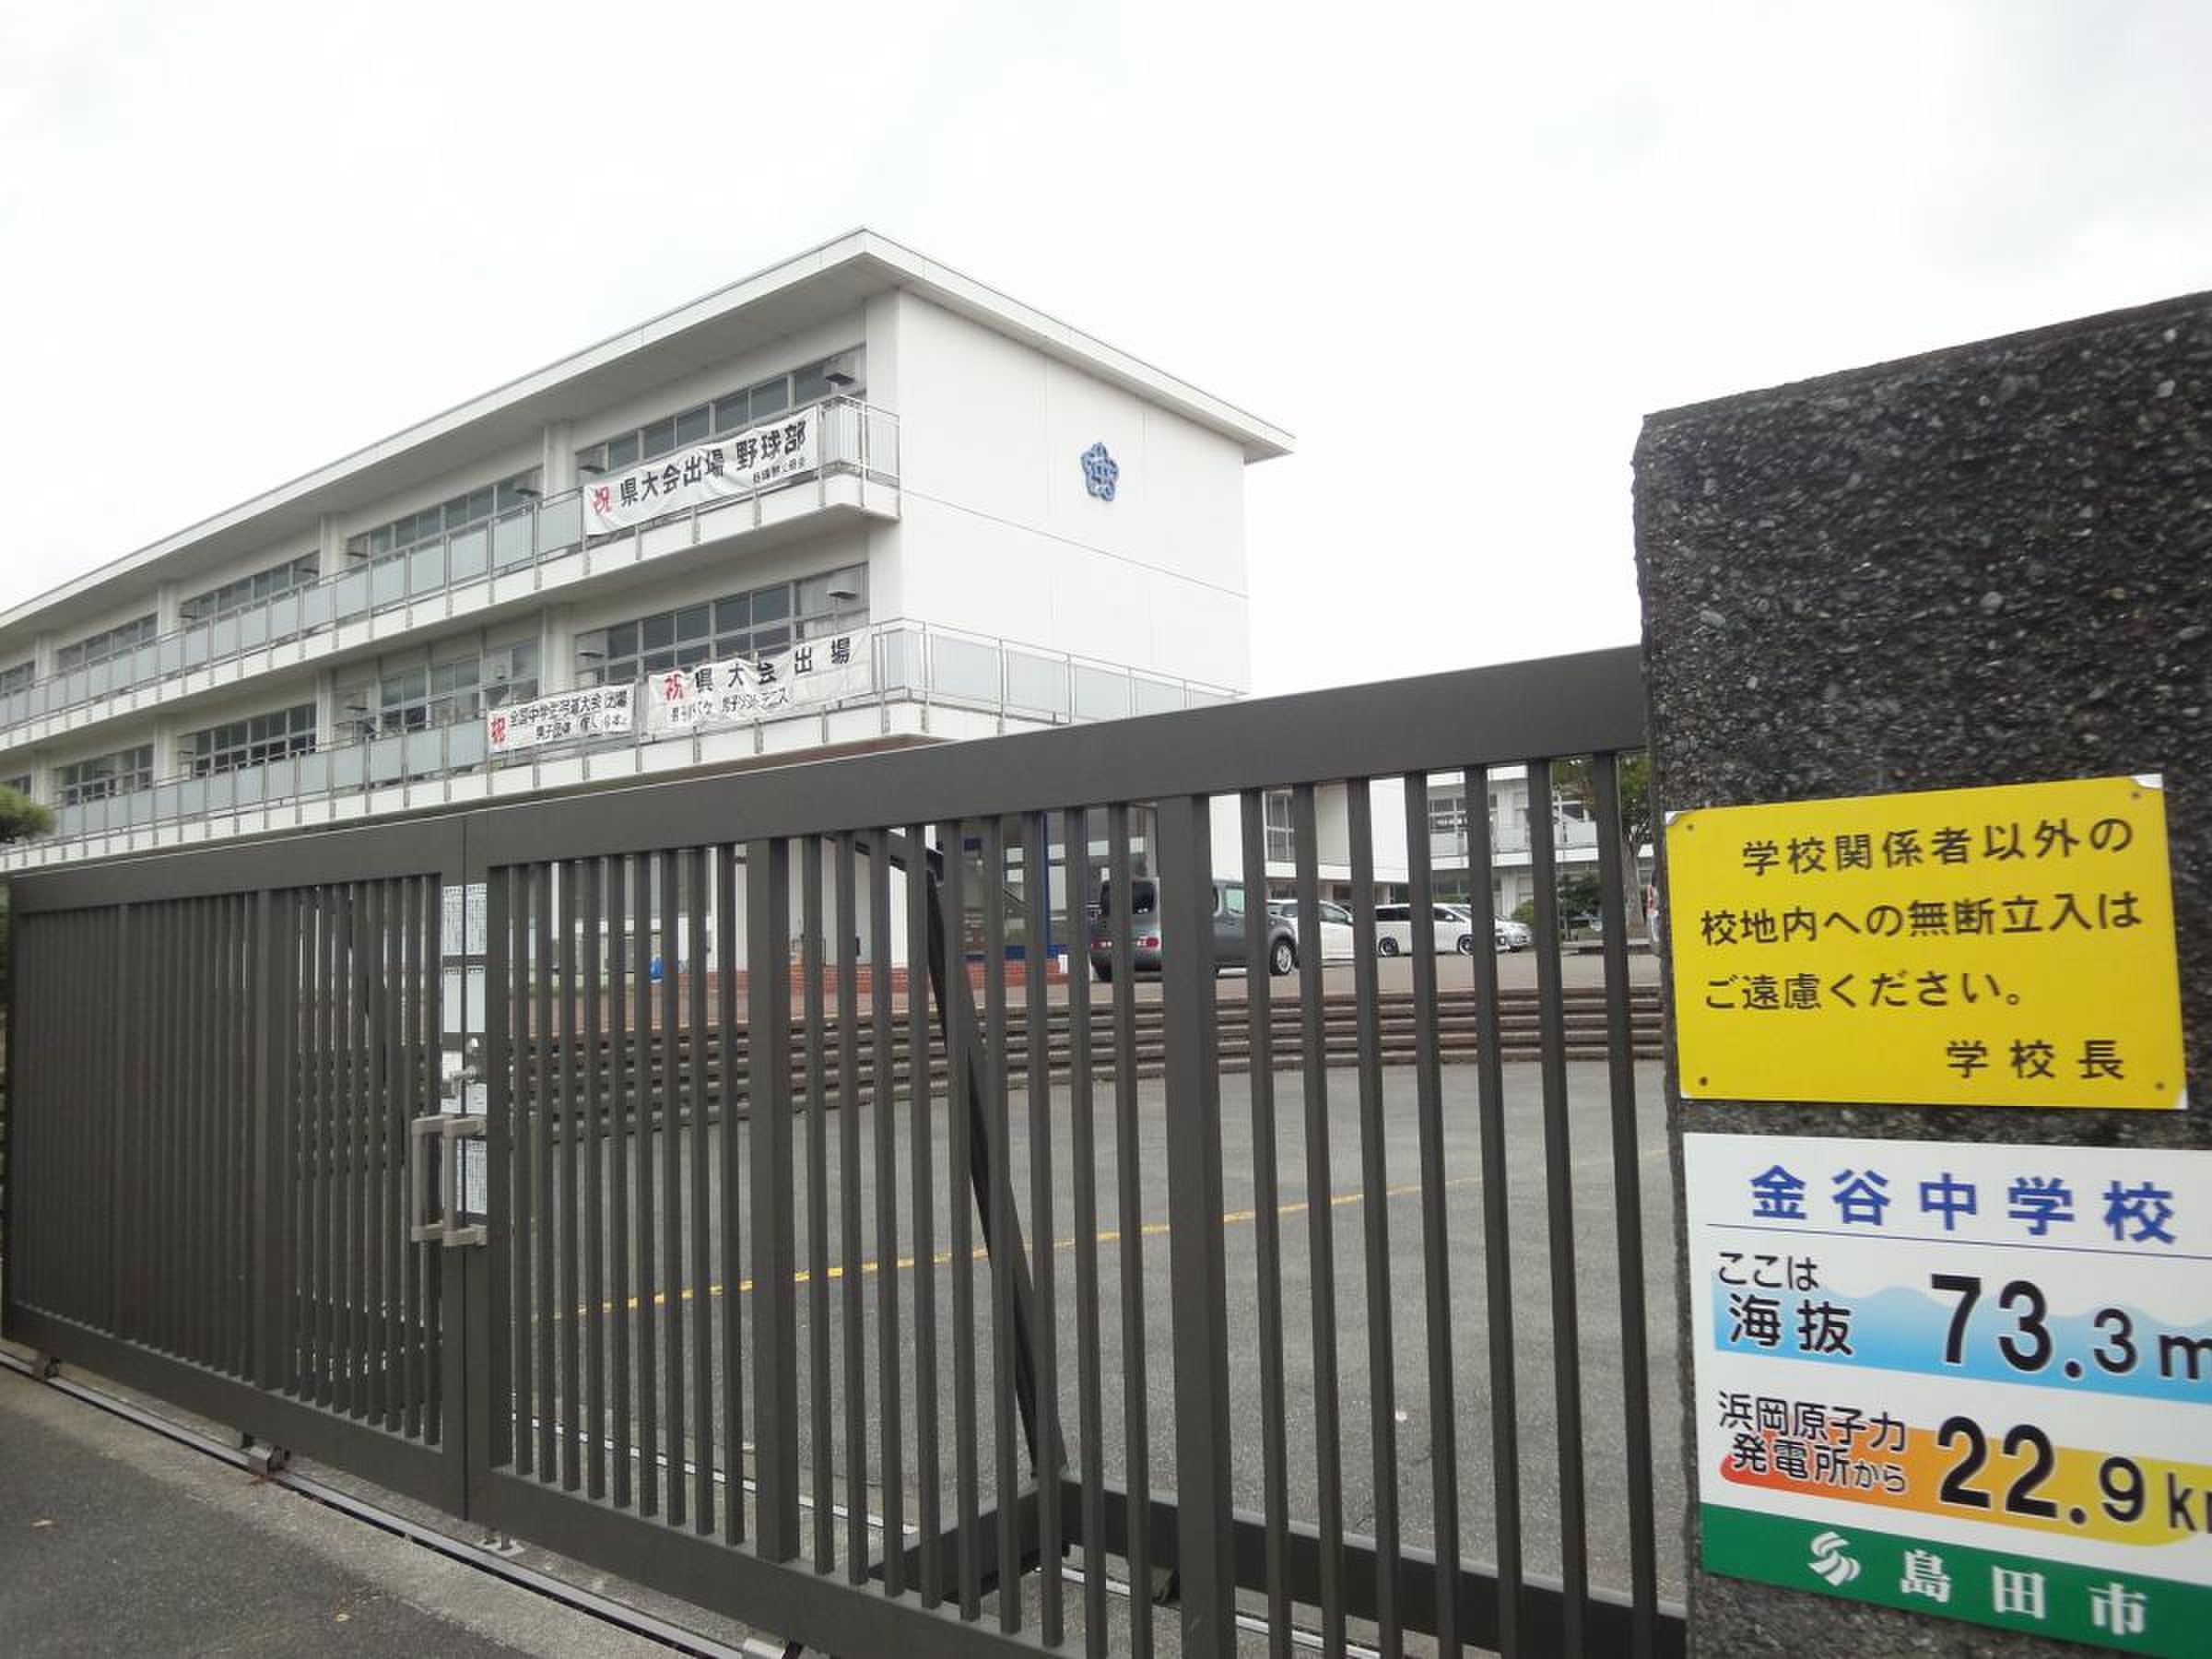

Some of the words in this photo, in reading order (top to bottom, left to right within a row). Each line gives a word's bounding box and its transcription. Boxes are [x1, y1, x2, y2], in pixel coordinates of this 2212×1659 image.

[619, 447, 725, 508] 県大会出場
[735, 420, 807, 472] 野球部
[695, 636, 851, 692] 県大会出場
[1741, 818, 2134, 877] 学校関係者以外の
[1700, 891, 2142, 946] 校地内への無断立入は
[1705, 970, 2022, 1011] ご遠慮ください。
[1946, 1040, 2125, 1080] 学校長
[1750, 1164, 2177, 1245] 金谷中学校
[1718, 1252, 1819, 1290] ここは
[1729, 1293, 1853, 1357] 海抜
[1718, 1391, 1907, 1453] 浜岡原子力
[1733, 1432, 1906, 1493] 発電所から
[1900, 1548, 2148, 1637] 島田市
